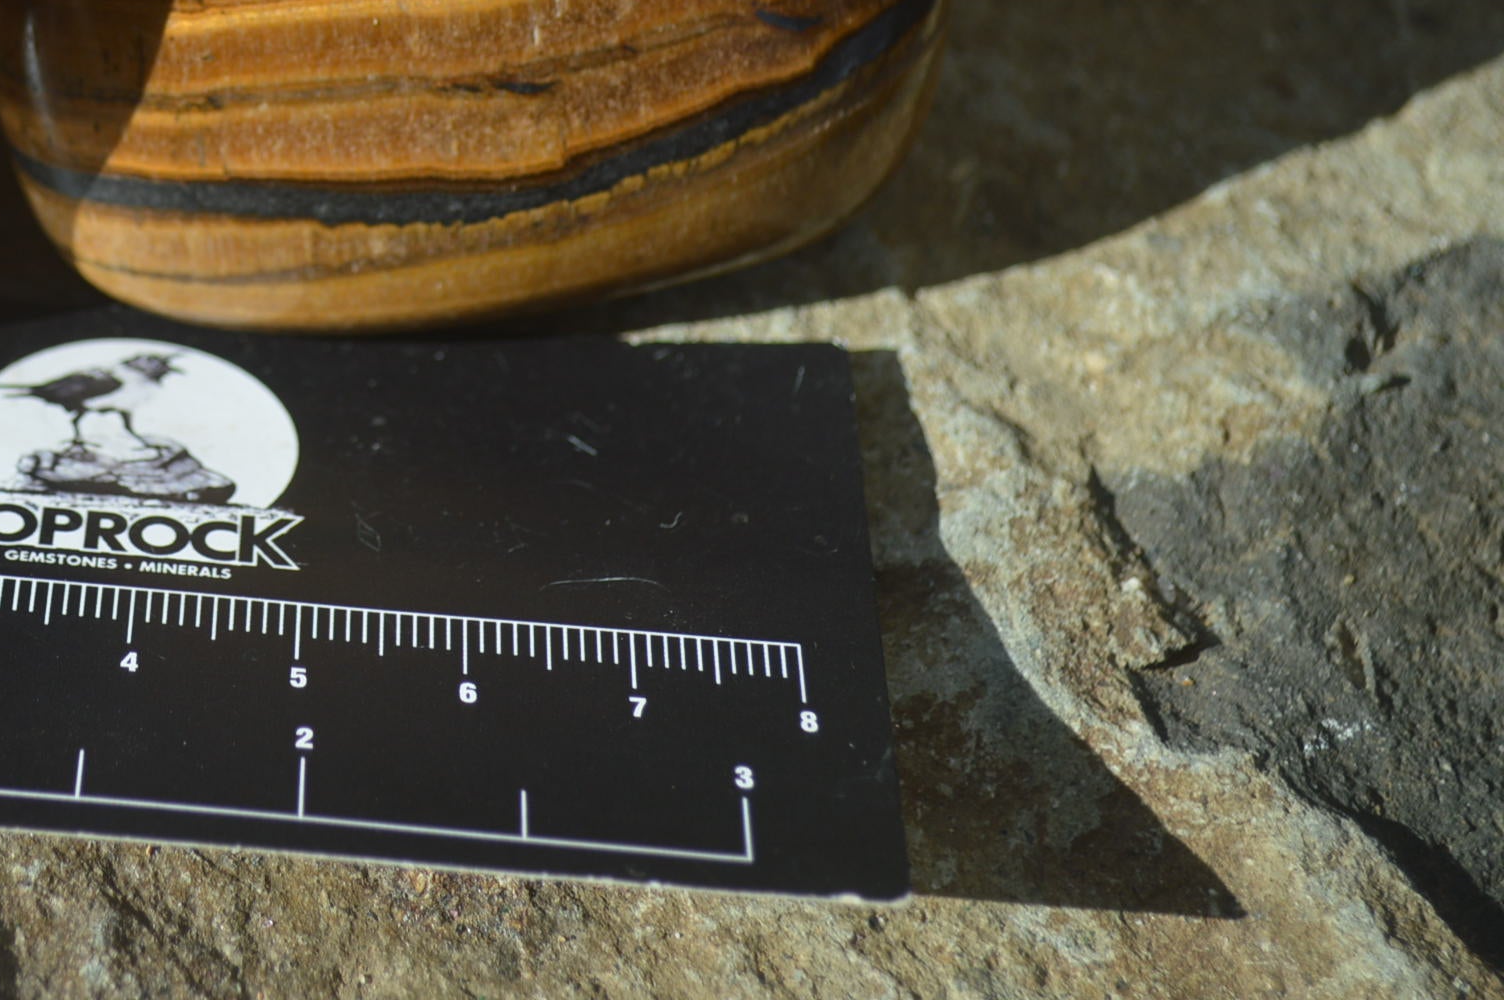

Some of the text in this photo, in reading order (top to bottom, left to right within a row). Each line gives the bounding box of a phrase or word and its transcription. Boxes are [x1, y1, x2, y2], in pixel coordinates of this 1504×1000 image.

[4, 549, 232, 580] GEMSTONES MINERALS
[119, 651, 139, 673] 4
[289, 666, 308, 689] 5
[458, 681, 478, 704] 6
[628, 696, 647, 718] 7
[799, 710, 819, 733] 8
[294, 726, 314, 750] 2
[734, 765, 755, 790] 3
